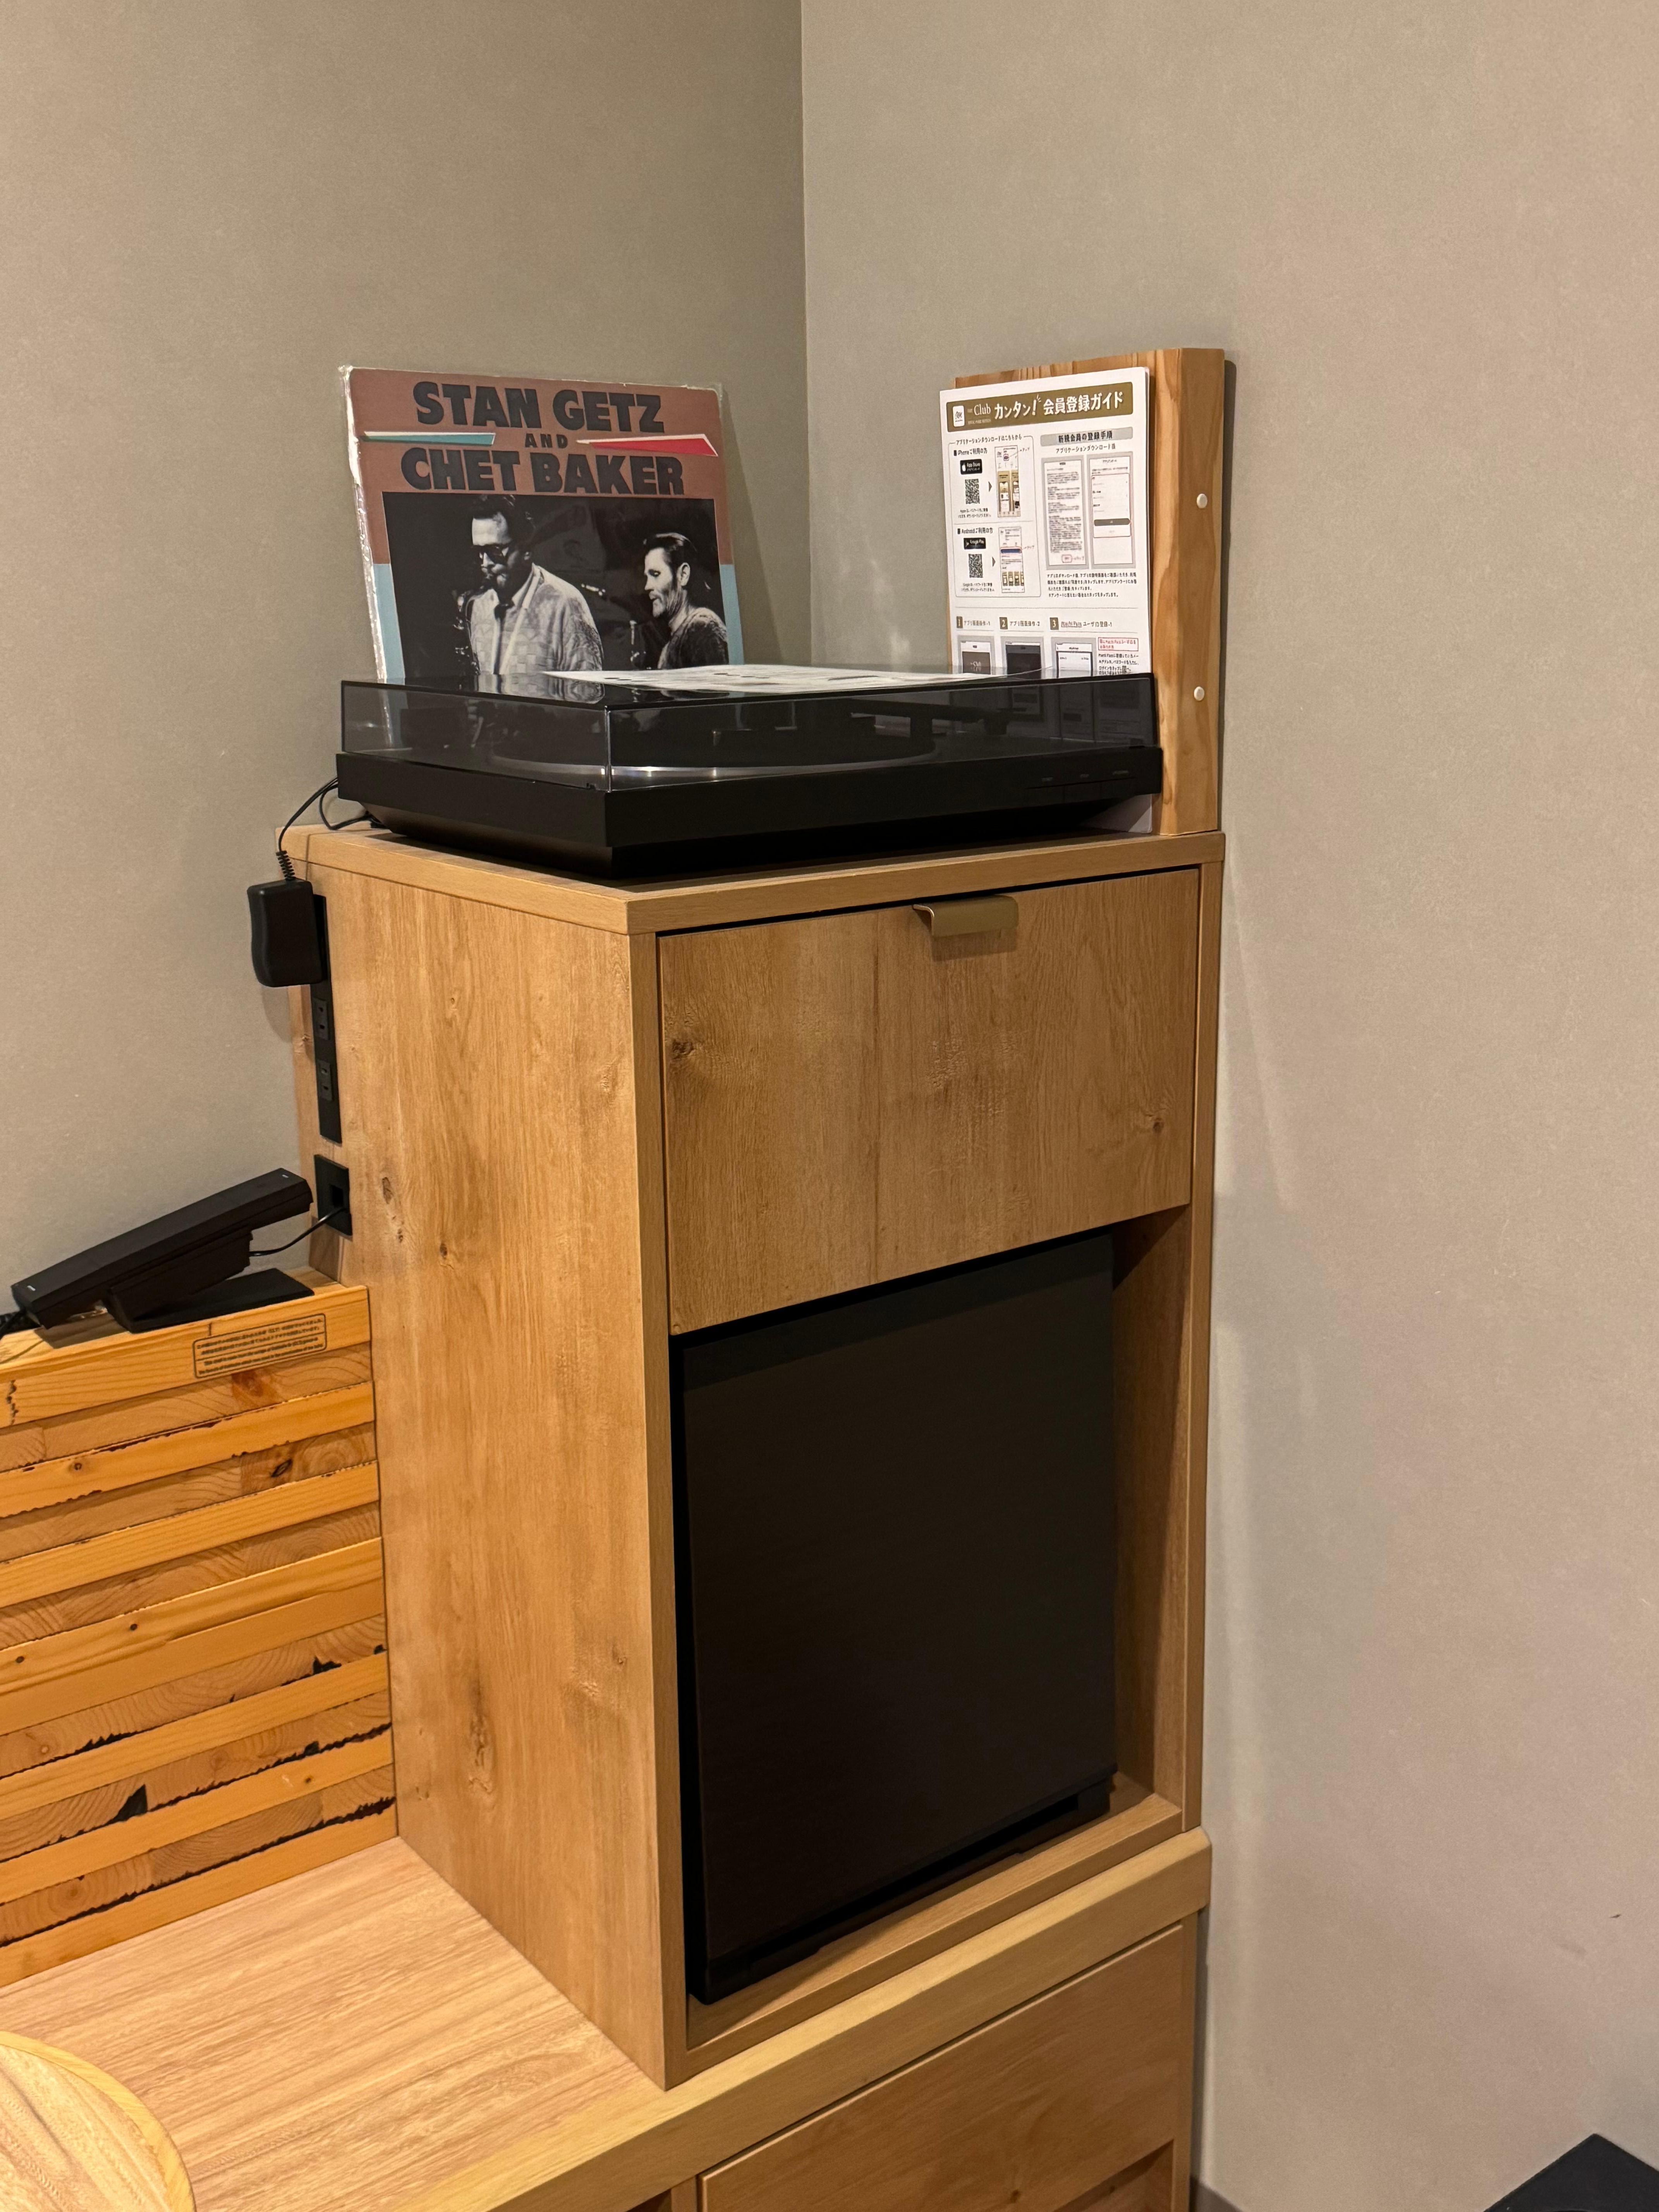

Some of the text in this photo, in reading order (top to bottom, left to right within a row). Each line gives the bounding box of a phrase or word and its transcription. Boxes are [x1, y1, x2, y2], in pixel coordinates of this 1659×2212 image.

[413, 381, 665, 433] STAN GETZ
[974, 403, 991, 415] Club
[1043, 392, 1123, 416] 会員登録ガイド
[525, 433, 568, 449] AND
[401, 447, 684, 495] CHET BAKER
